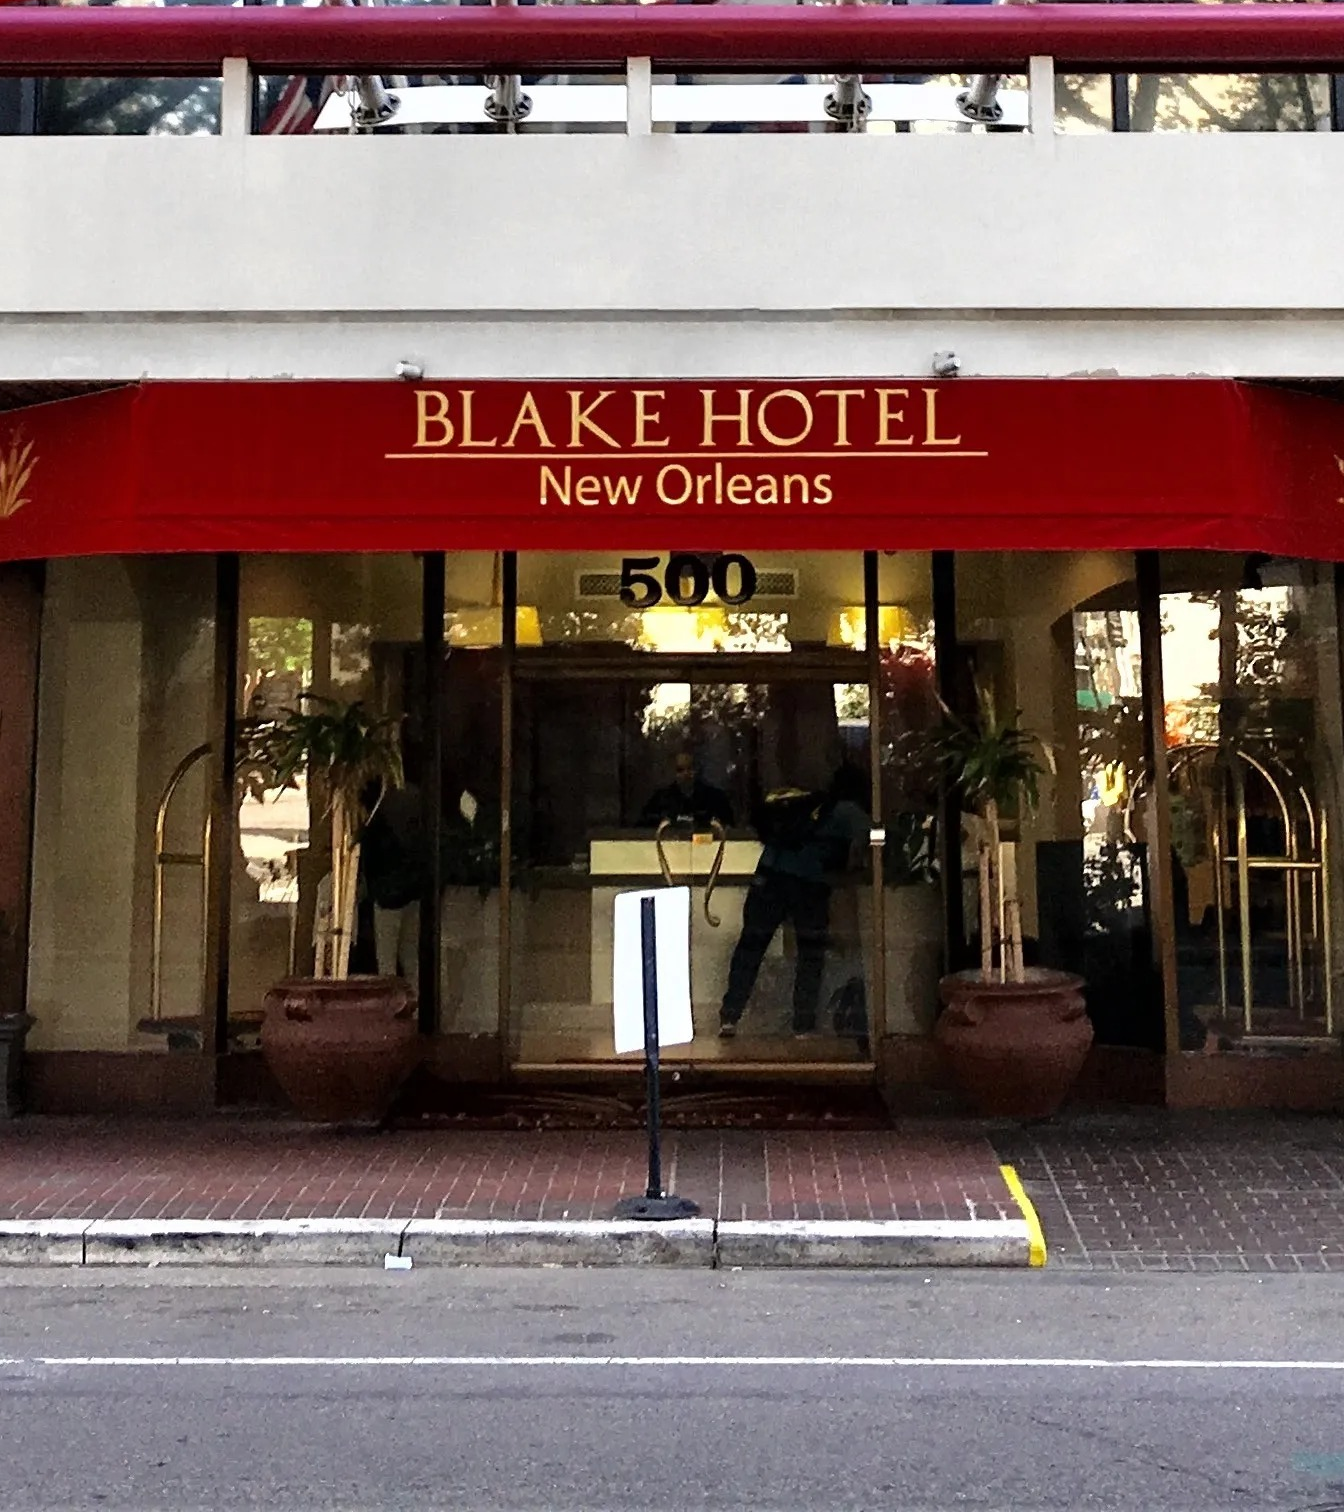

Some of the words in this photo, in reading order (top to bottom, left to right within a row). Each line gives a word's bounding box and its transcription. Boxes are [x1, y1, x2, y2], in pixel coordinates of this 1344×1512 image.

[413, 390, 669, 448] BLAKE
[699, 388, 961, 447] HOTEL
[540, 465, 642, 506] New
[655, 462, 833, 505] Orleans
[620, 555, 756, 608] 500
